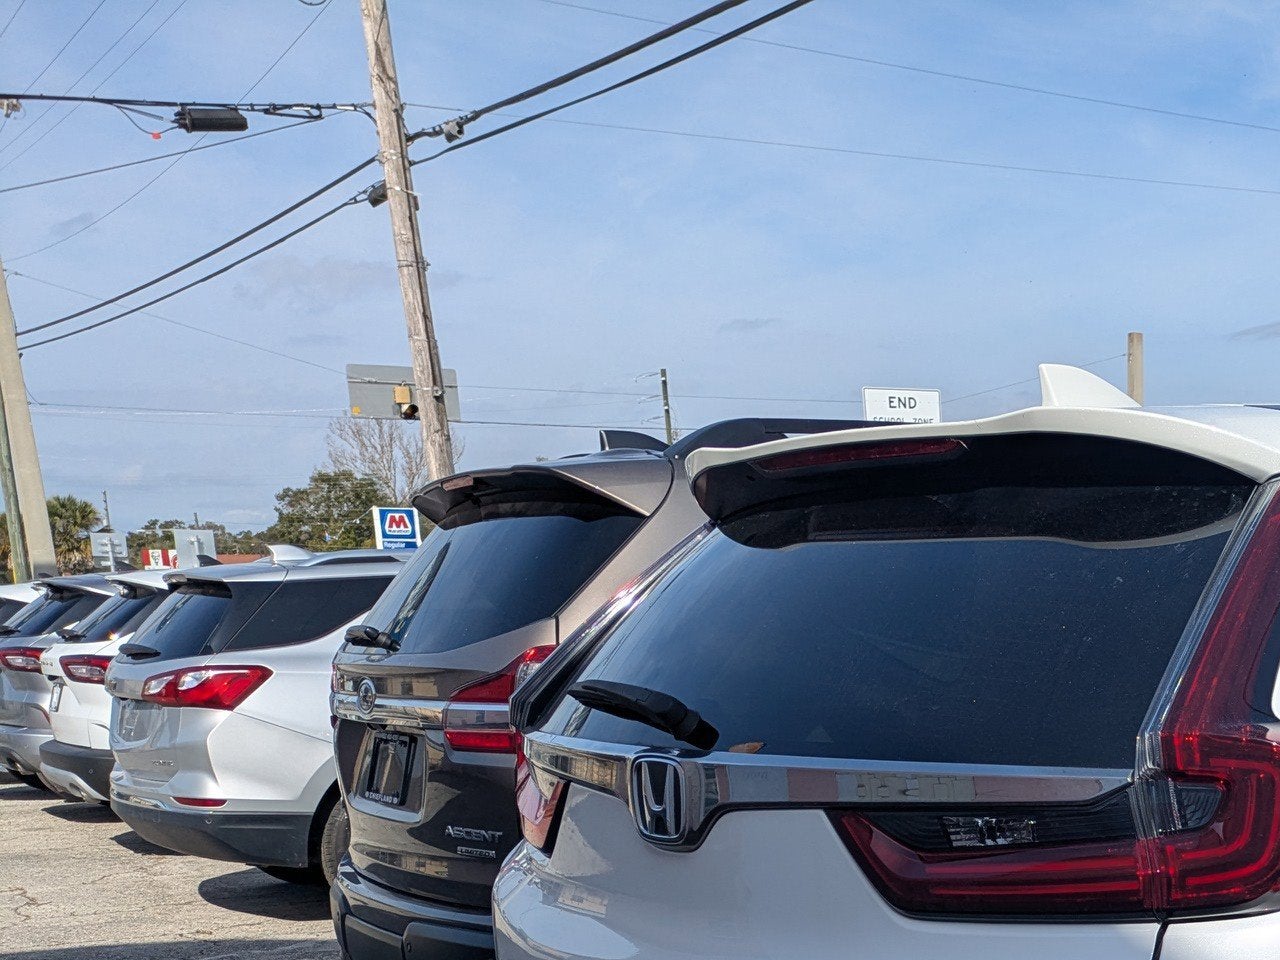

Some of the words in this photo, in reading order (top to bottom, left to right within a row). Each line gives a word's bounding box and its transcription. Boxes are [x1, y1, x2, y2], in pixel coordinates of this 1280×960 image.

[888, 396, 917, 409] END
[388, 514, 409, 529] M
[445, 825, 503, 843] ASCENT
